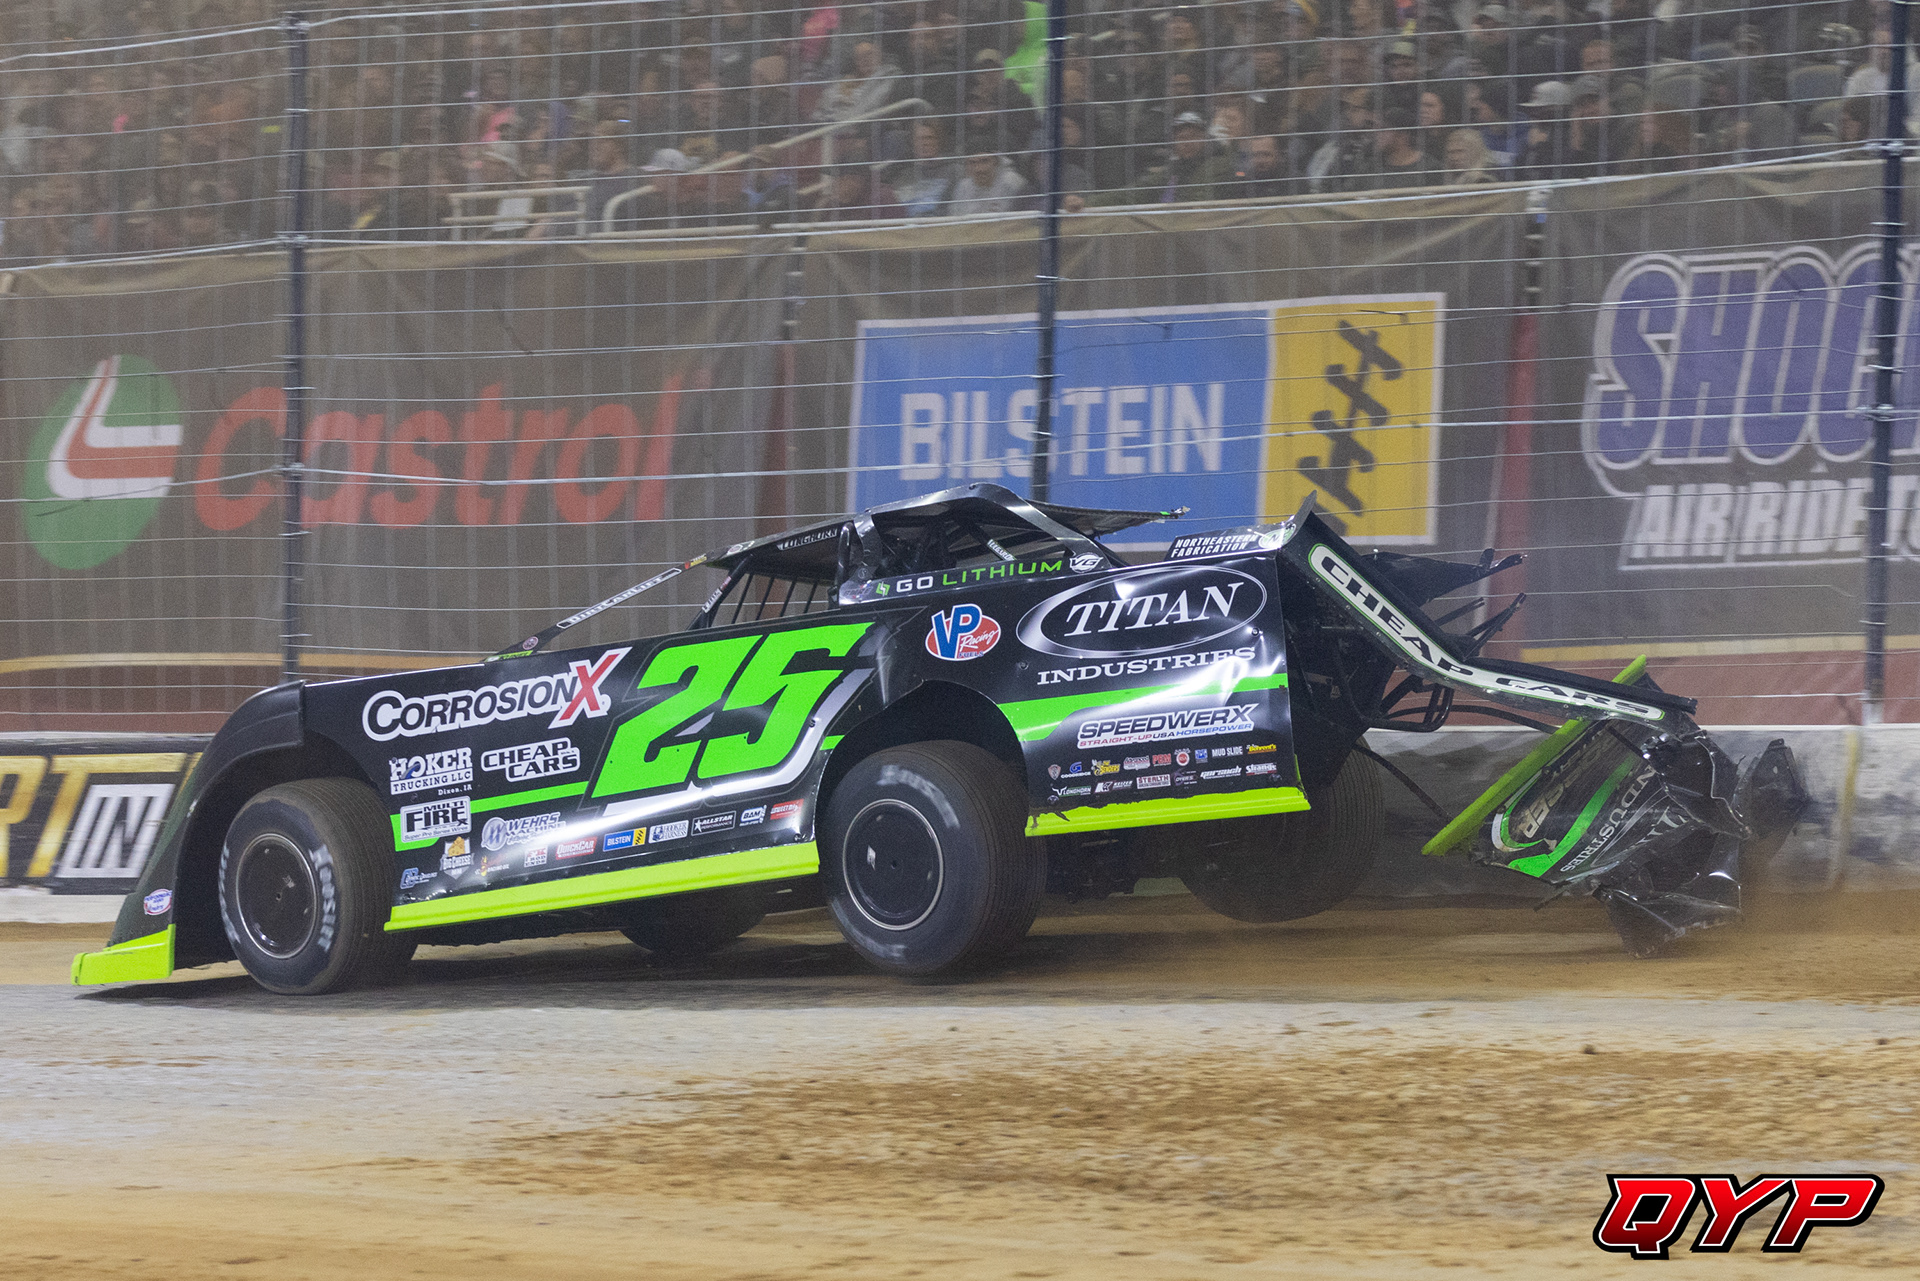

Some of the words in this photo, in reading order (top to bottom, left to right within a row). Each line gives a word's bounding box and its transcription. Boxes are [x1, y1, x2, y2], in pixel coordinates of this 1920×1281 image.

[900, 383, 1226, 481] BILSTEIN
[195, 376, 684, 531] Castrol
[1171, 541, 1248, 558] FABRICATION
[1175, 534, 1259, 548] NORTHEASTERN
[896, 576, 934, 593] GO
[942, 560, 1063, 586] LITHIUM
[1064, 582, 1244, 636] TITAN
[931, 604, 982, 659] VP
[960, 631, 999, 652] Racing
[1321, 556, 1473, 676] CHEAP
[1495, 677, 1649, 713] CARS
[1037, 647, 1256, 685] INDUSTRIES
[592, 622, 875, 798] 25
[1080, 705, 1256, 740] SPEEDWERX
[1080, 733, 1152, 747] STRAIGHT-UP
[1153, 731, 1175, 740] USA
[1176, 723, 1252, 736] HORSEPOWER
[390, 747, 473, 782] HOKER
[484, 738, 570, 769] CHEAP
[1212, 747, 1226, 757] MUD
[1226, 746, 1243, 756] SLIDE
[508, 753, 579, 779] CARS
[393, 772, 448, 793] TRUCKING
[451, 770, 471, 784] LLC
[423, 800, 464, 812] MULTI
[701, 815, 734, 825] ALLSTAR
[743, 811, 761, 819] BAM
[1560, 764, 1656, 872] NDUSTRIES
[509, 812, 560, 831] WEHRS
[607, 834, 632, 846] BILSTEIN
